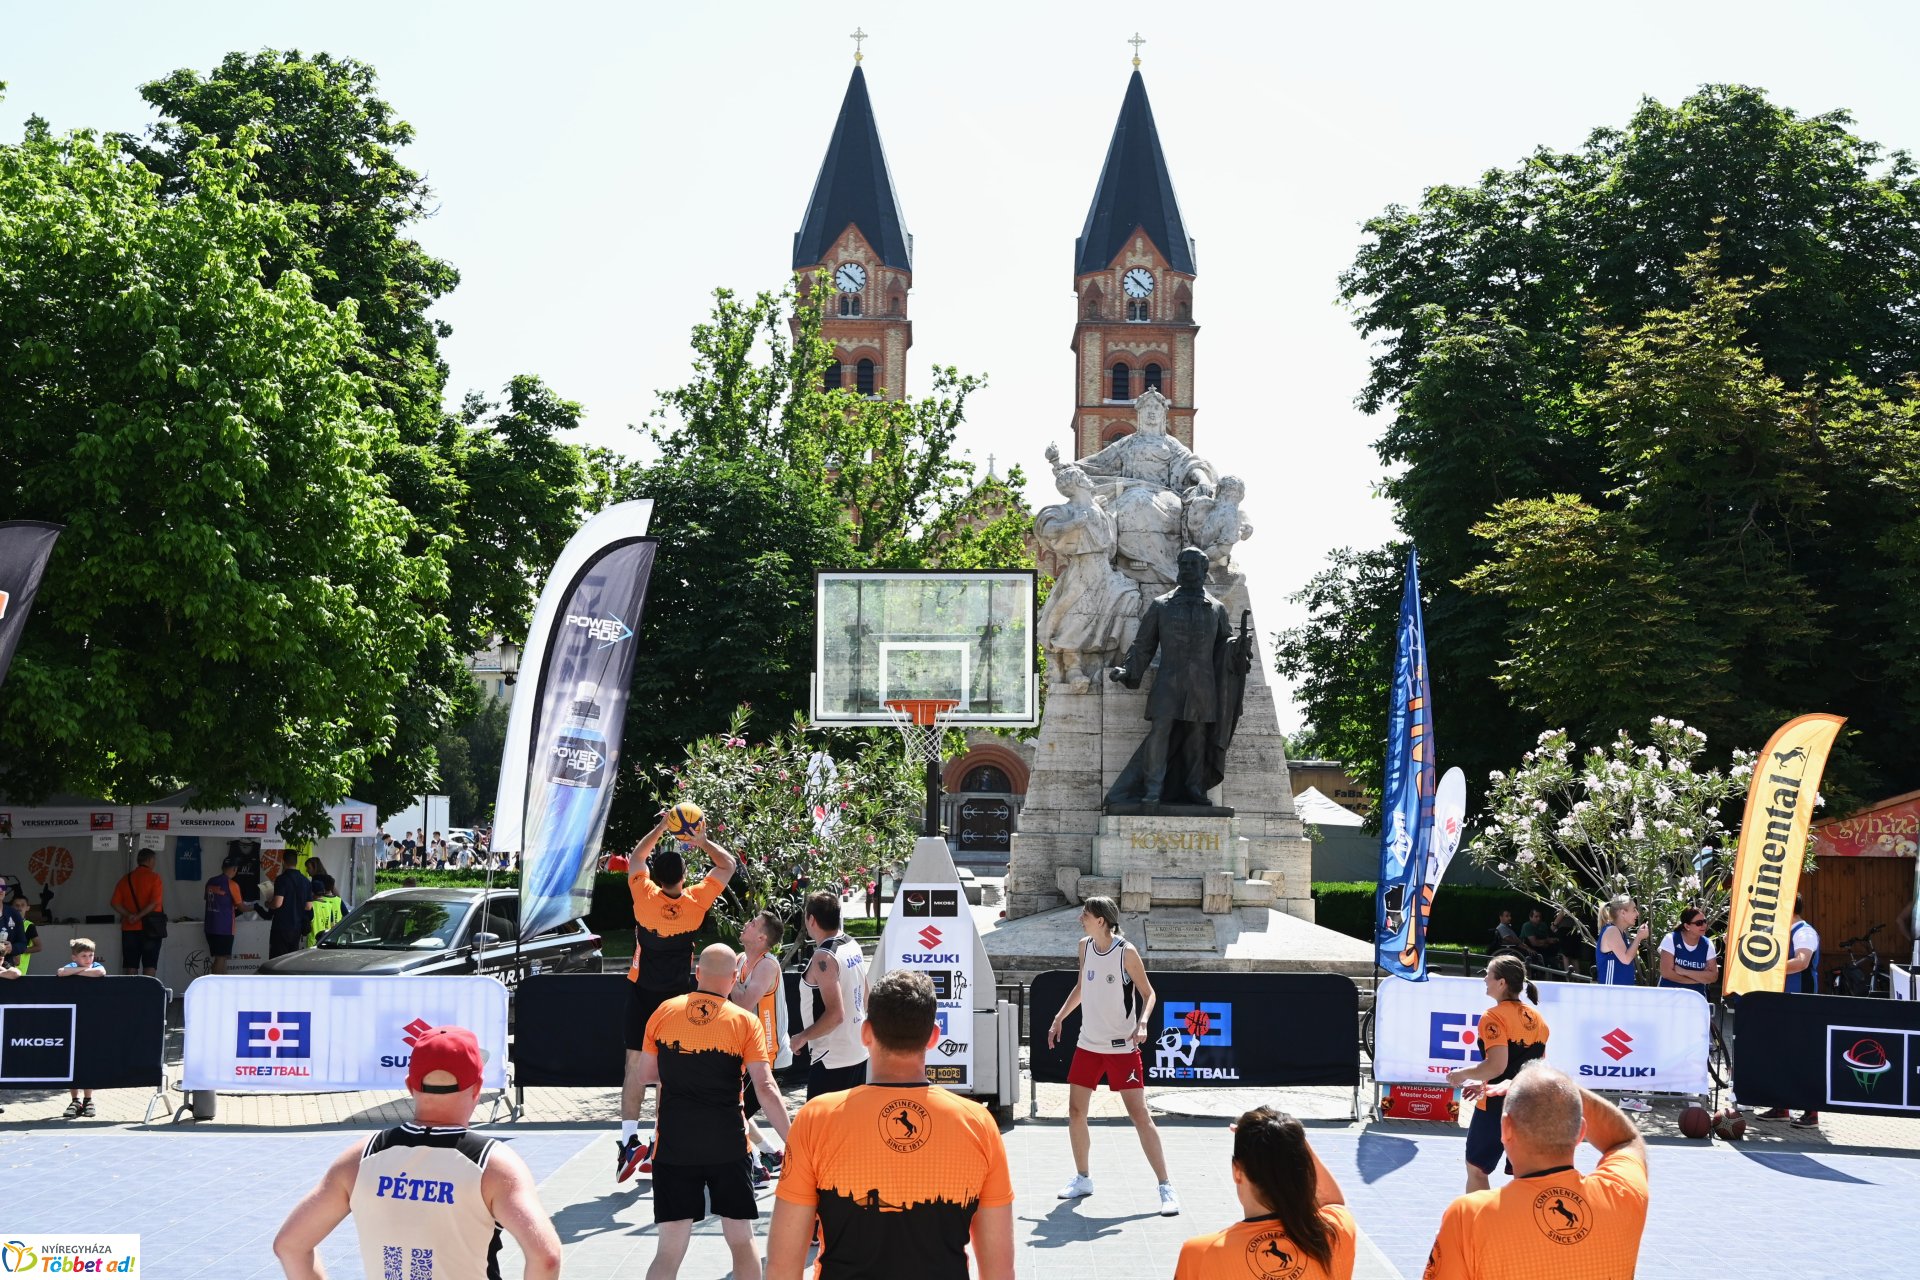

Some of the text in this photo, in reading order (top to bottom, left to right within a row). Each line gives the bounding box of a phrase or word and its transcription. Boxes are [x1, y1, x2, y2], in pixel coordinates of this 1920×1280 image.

[566, 615, 623, 633] POWER
[588, 630, 620, 643] ADE
[550, 747, 599, 763] POWER
[566, 758, 597, 772] ADE
[1131, 832, 1219, 850] KOSSUTH
[1738, 774, 1802, 972] Continental
[902, 954, 959, 963] SUZUKI
[10, 1037, 65, 1047] MKOSZ
[945, 1043, 968, 1053] TOTI
[235, 1066, 310, 1077] STREETBALL
[1149, 1067, 1239, 1079] STREETBALL
[1579, 1064, 1656, 1077] SUZUKI
[881, 1101, 928, 1120] CONTINENTAL
[887, 1138, 924, 1151] SINCE 1871
[376, 1172, 455, 1204] PÉTER
[1535, 1189, 1583, 1209] CONTINENTAL
[1248, 1231, 1287, 1253] CONTINEN
[1547, 1227, 1589, 1243] SINCE 1871
